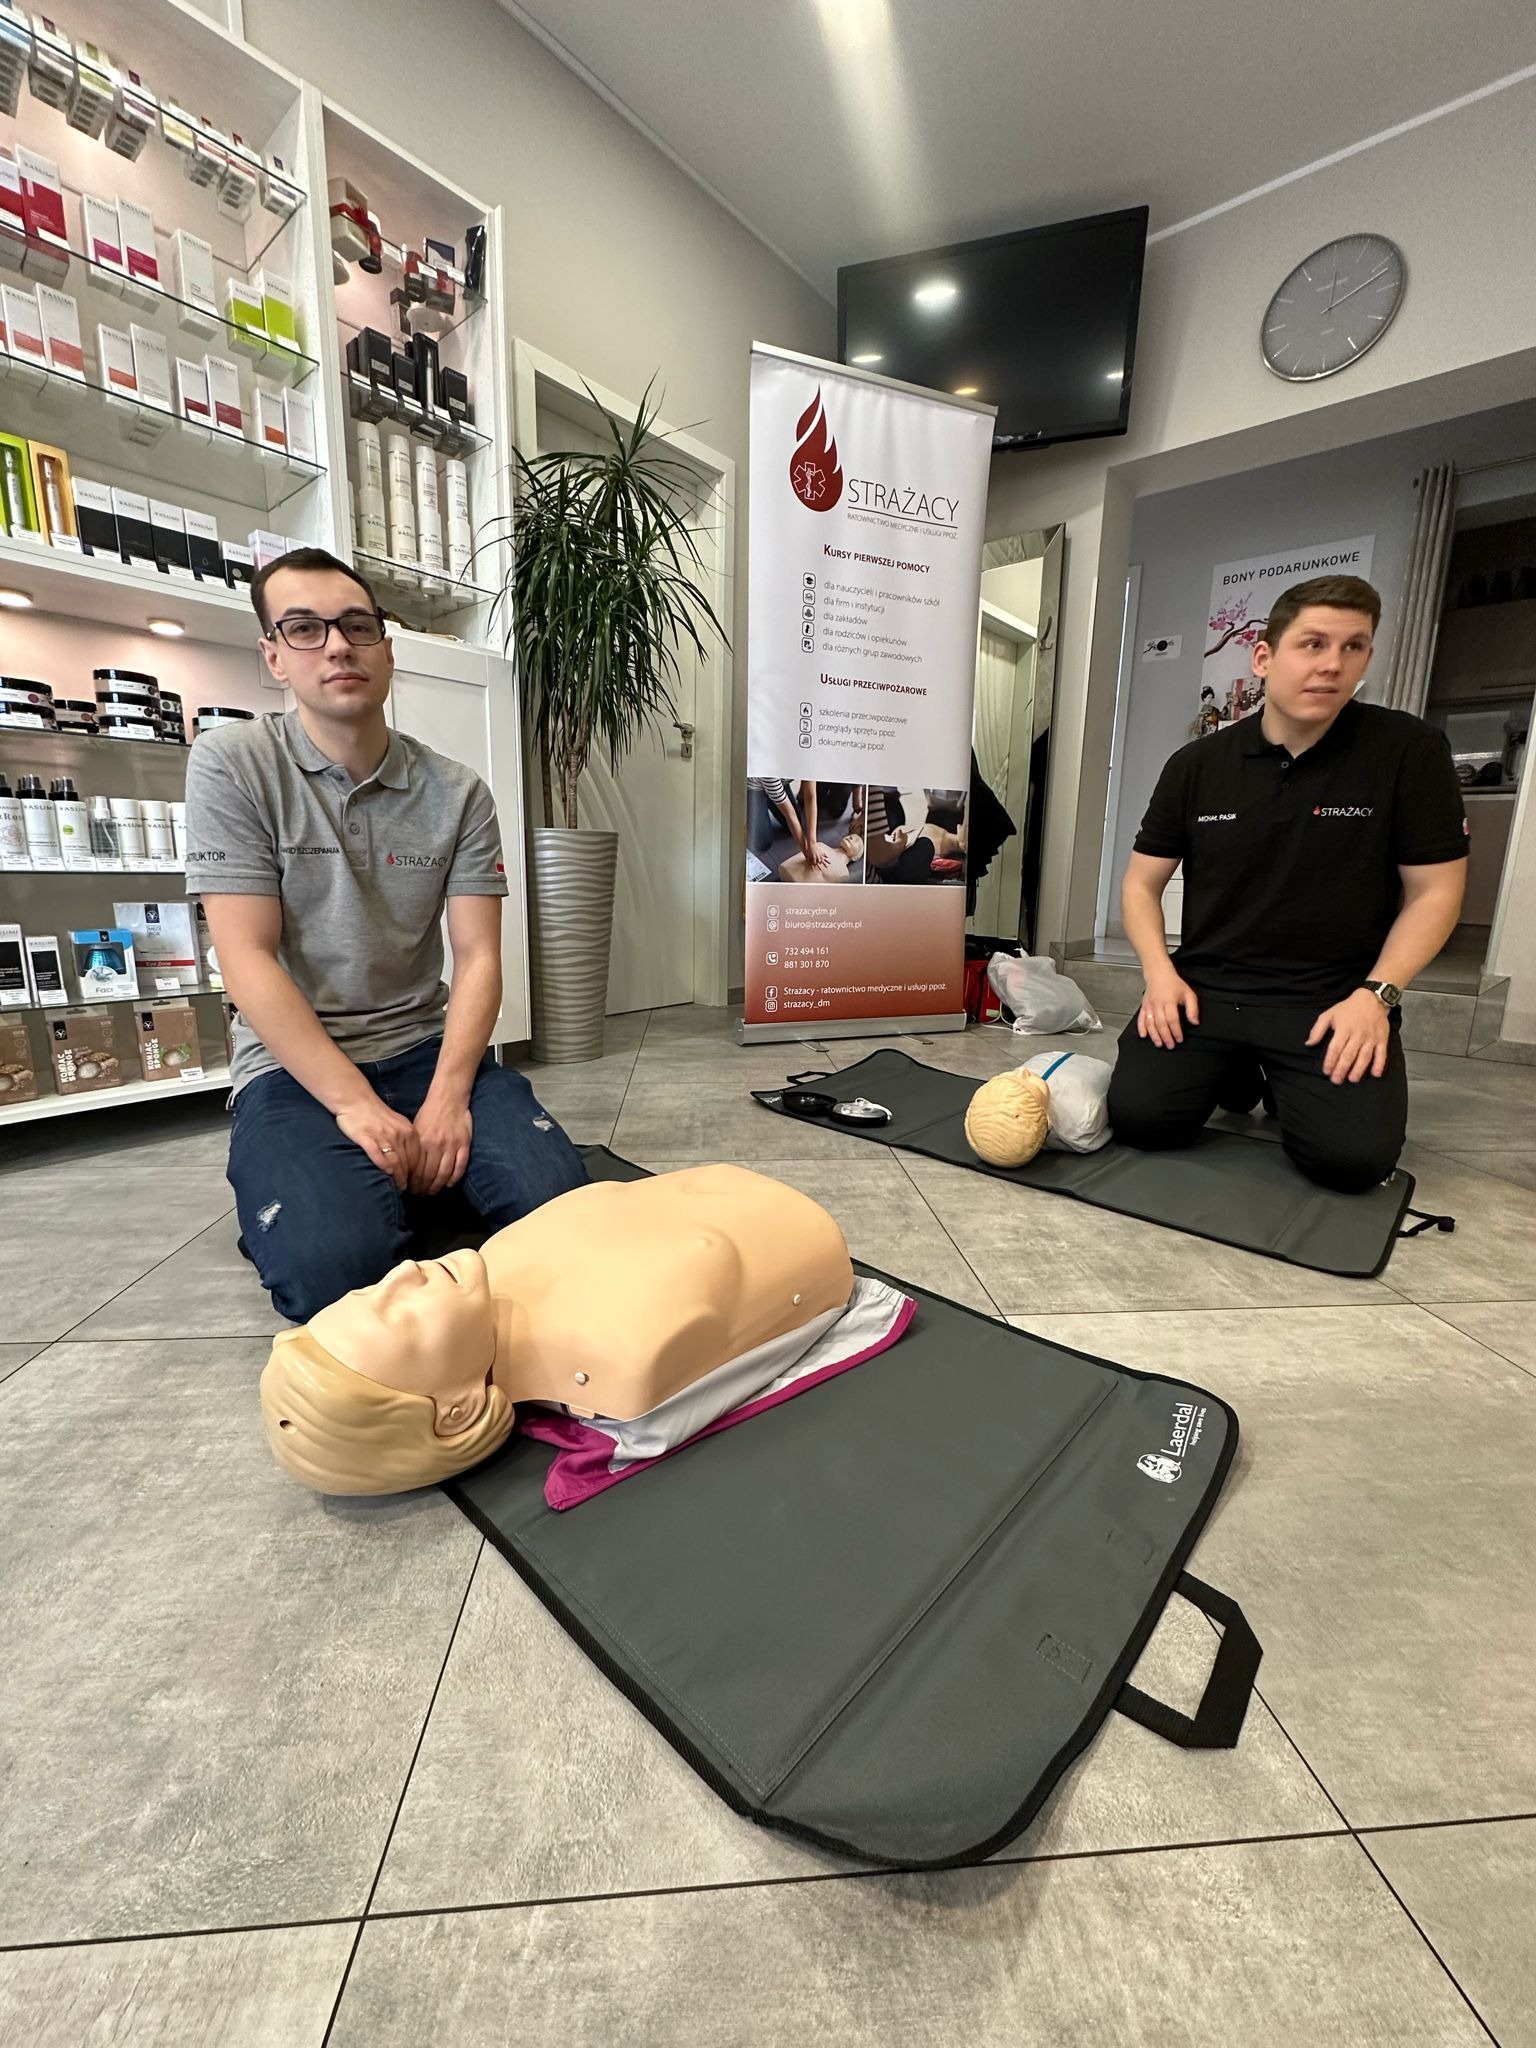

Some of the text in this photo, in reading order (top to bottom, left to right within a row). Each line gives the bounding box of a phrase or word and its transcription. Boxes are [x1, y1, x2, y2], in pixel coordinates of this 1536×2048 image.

[848, 479, 959, 521] STRAŻACY
[848, 512, 889, 527] RATOWNICTWO
[890, 520, 918, 533] MEDYCZNE
[854, 552, 895, 568] PIERWSZEJ
[896, 560, 930, 573] POMOCY
[1223, 551, 1360, 585] BONY PODARUNKOWE
[824, 581, 835, 590] dla
[836, 583, 874, 596] nauczycieli
[879, 590, 922, 605] pracowników
[824, 596, 835, 606] dla
[836, 598, 850, 608] firm
[855, 600, 885, 615] instytucji
[823, 612, 868, 625] dla zakładów
[823, 628, 834, 636] dla
[835, 629, 866, 640] rodziców
[871, 634, 907, 647] opiekunów
[822, 643, 923, 664] dla różnych grup zawodowych
[853, 679, 927, 696] PRZECIWPOŻAROWE
[819, 708, 850, 718] szkolenia
[853, 727, 878, 736] sprzętu
[818, 738, 866, 750] dokumentacja
[1320, 806, 1374, 818] STRAŻACY
[396, 856, 448, 868] STRAŻACY
[785, 947, 829, 956] 732 494 161
[784, 960, 830, 969] 881 301 870
[821, 985, 866, 994] ratownictwo
[868, 984, 903, 994] medyczne
[907, 982, 928, 993] usługi
[64, 1049, 77, 1082] SPONGE
[145, 1042, 155, 1071] KONJAC
[57, 1053, 69, 1083] KONJAC
[1161, 1403, 1194, 1457] Laerdal
